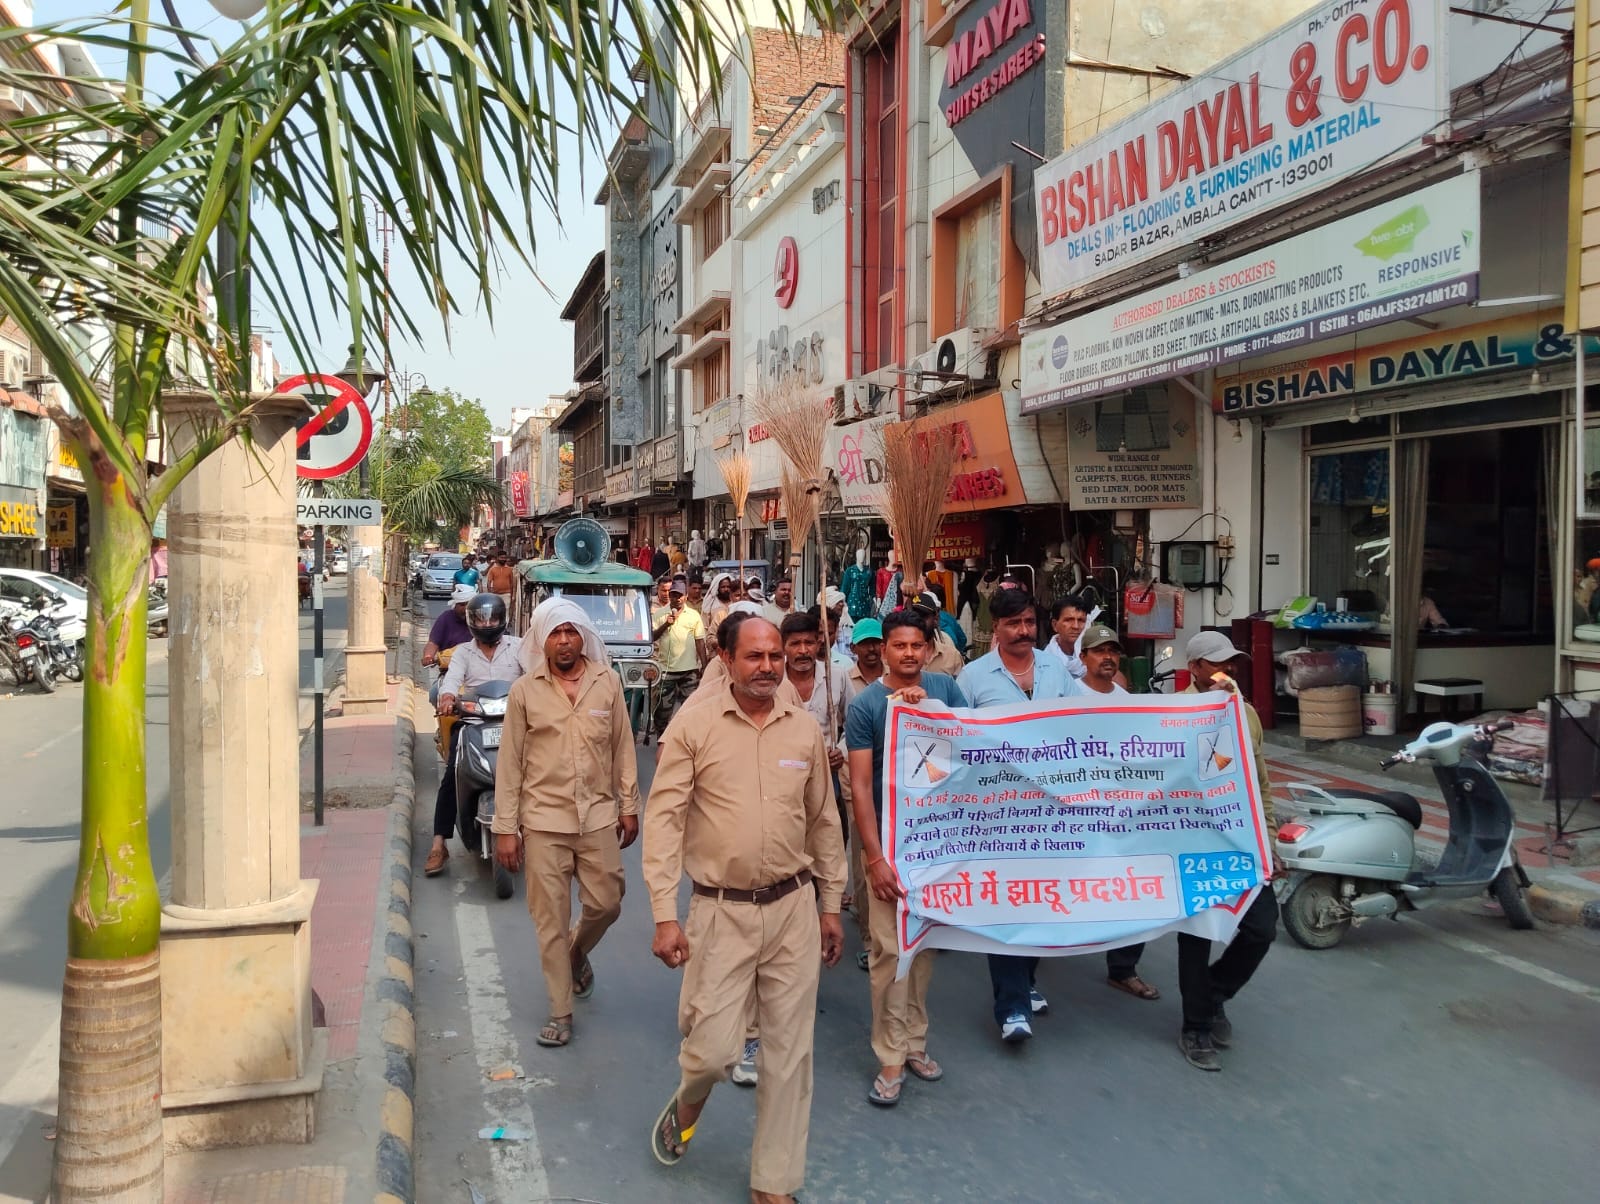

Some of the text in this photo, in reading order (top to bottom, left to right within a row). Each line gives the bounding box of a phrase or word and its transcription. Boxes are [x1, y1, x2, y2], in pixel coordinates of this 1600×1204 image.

[948, 0, 1031, 88] MAYA
[1041, 0, 1429, 247] BISHAN DAYAL & CO.
[1067, 230, 1101, 261] DEALS
[1122, 191, 1182, 236] FLOORING
[1184, 185, 1197, 209] &
[1199, 143, 1283, 203] FURNISHING
[1288, 102, 1382, 163] MATERIAL
[1094, 242, 1128, 267] SADAR
[1130, 224, 1175, 251] BAZAR,
[1175, 201, 1227, 232] AMBALA
[1378, 245, 1461, 284] RESPONSIVE
[1113, 260, 1276, 329] AUTHORISED DEALERS & STOCKISTS
[1112, 336, 1124, 351] NON
[1125, 331, 1144, 348] WOVEN
[1186, 307, 1214, 327] MATTING
[1220, 299, 1241, 318] MATS,
[1243, 280, 1296, 310] DUROMATTING
[1299, 264, 1343, 289] PRODUCTS
[1059, 369, 1075, 385] FLOOR
[1101, 357, 1123, 373] RECRON
[1152, 345, 1165, 358] BED
[1189, 327, 1219, 346] TOWELS,
[1220, 315, 1261, 339] ARTIFICIAL
[1263, 306, 1290, 327] GRASS
[1292, 303, 1298, 318] &
[1301, 289, 1346, 316] BLANKETS
[1349, 282, 1370, 302] ETC.
[1319, 315, 1348, 333] GSTIN
[1223, 323, 1575, 411] BISHAN DAYAL &
[1074, 465, 1105, 473] ARTISTIC
[1114, 464, 1158, 472] EXCLUSIVELY
[1160, 463, 1193, 471] DESIGNED
[1081, 485, 1100, 493] BED
[1134, 484, 1159, 492] DOOR
[1084, 494, 1186, 505] BATH & KITCHEN MATS
[296, 504, 373, 520] PARKING
[939, 546, 981, 559] GOWN
[1120, 734, 1186, 761] हरियाणा
[1089, 766, 1110, 781] संघ
[1114, 765, 1164, 782] हरियाणा
[951, 794, 978, 804] 2026
[982, 792, 996, 805] को
[998, 789, 1017, 803] होने
[1147, 788, 1163, 800] को
[1044, 804, 1055, 817] के
[1118, 803, 1133, 819] की
[1173, 804, 1189, 815] का
[961, 823, 1008, 838] हरियाणा
[1010, 823, 1047, 834] सरकार
[1051, 819, 1066, 833] की
[1135, 818, 1176, 832] वायदा
[1030, 838, 1040, 851] के
[1043, 838, 1085, 852] खिलाफ
[1183, 855, 1253, 874] 24 व 25
[921, 871, 973, 914] शहरों
[978, 869, 999, 906] में
[1068, 866, 1166, 905] प्रदर्शन
[1191, 874, 1250, 892] अप्रैल
